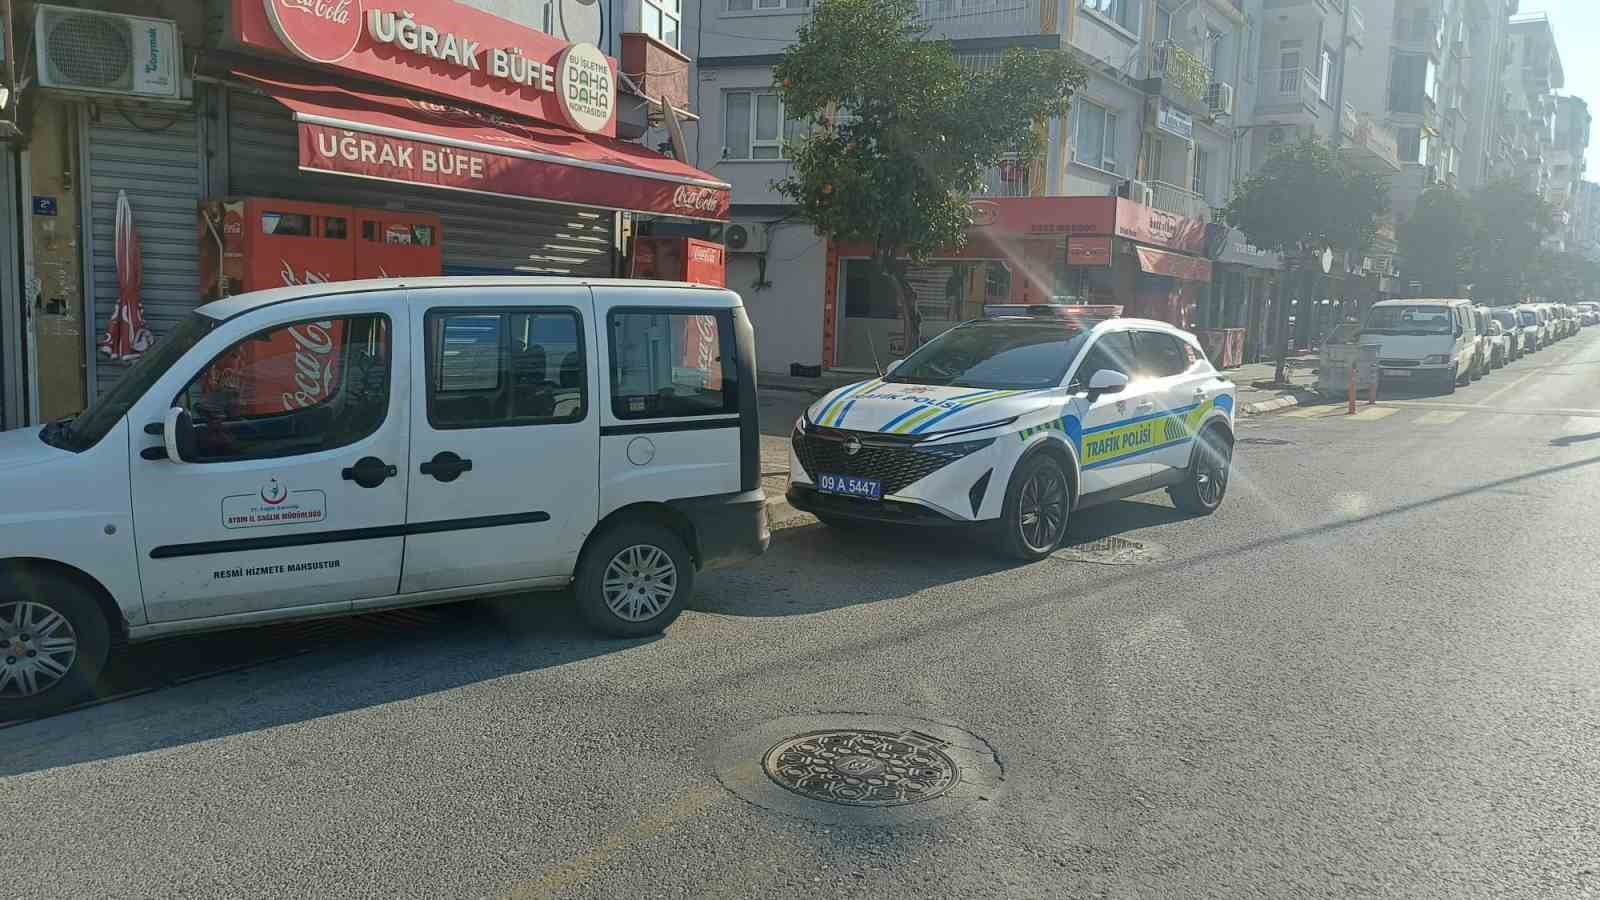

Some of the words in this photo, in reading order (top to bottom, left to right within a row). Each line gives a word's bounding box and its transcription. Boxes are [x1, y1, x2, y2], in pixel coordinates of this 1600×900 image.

[368, 9, 481, 71] UĞRAK
[487, 46, 556, 93] BÜFE
[568, 66, 609, 92] DAHA
[568, 84, 609, 110] DAHA
[317, 131, 414, 170] UĞRAK
[422, 147, 485, 179] BÜFE
[1086, 432, 1121, 458] TRAFİK
[1121, 424, 1151, 449] POLİSİ
[822, 475, 835, 490] 09
[836, 479, 846, 491] A
[848, 479, 879, 496] 5447
[213, 566, 243, 580] RESMİ
[287, 559, 341, 573] MAHSUSTUR
